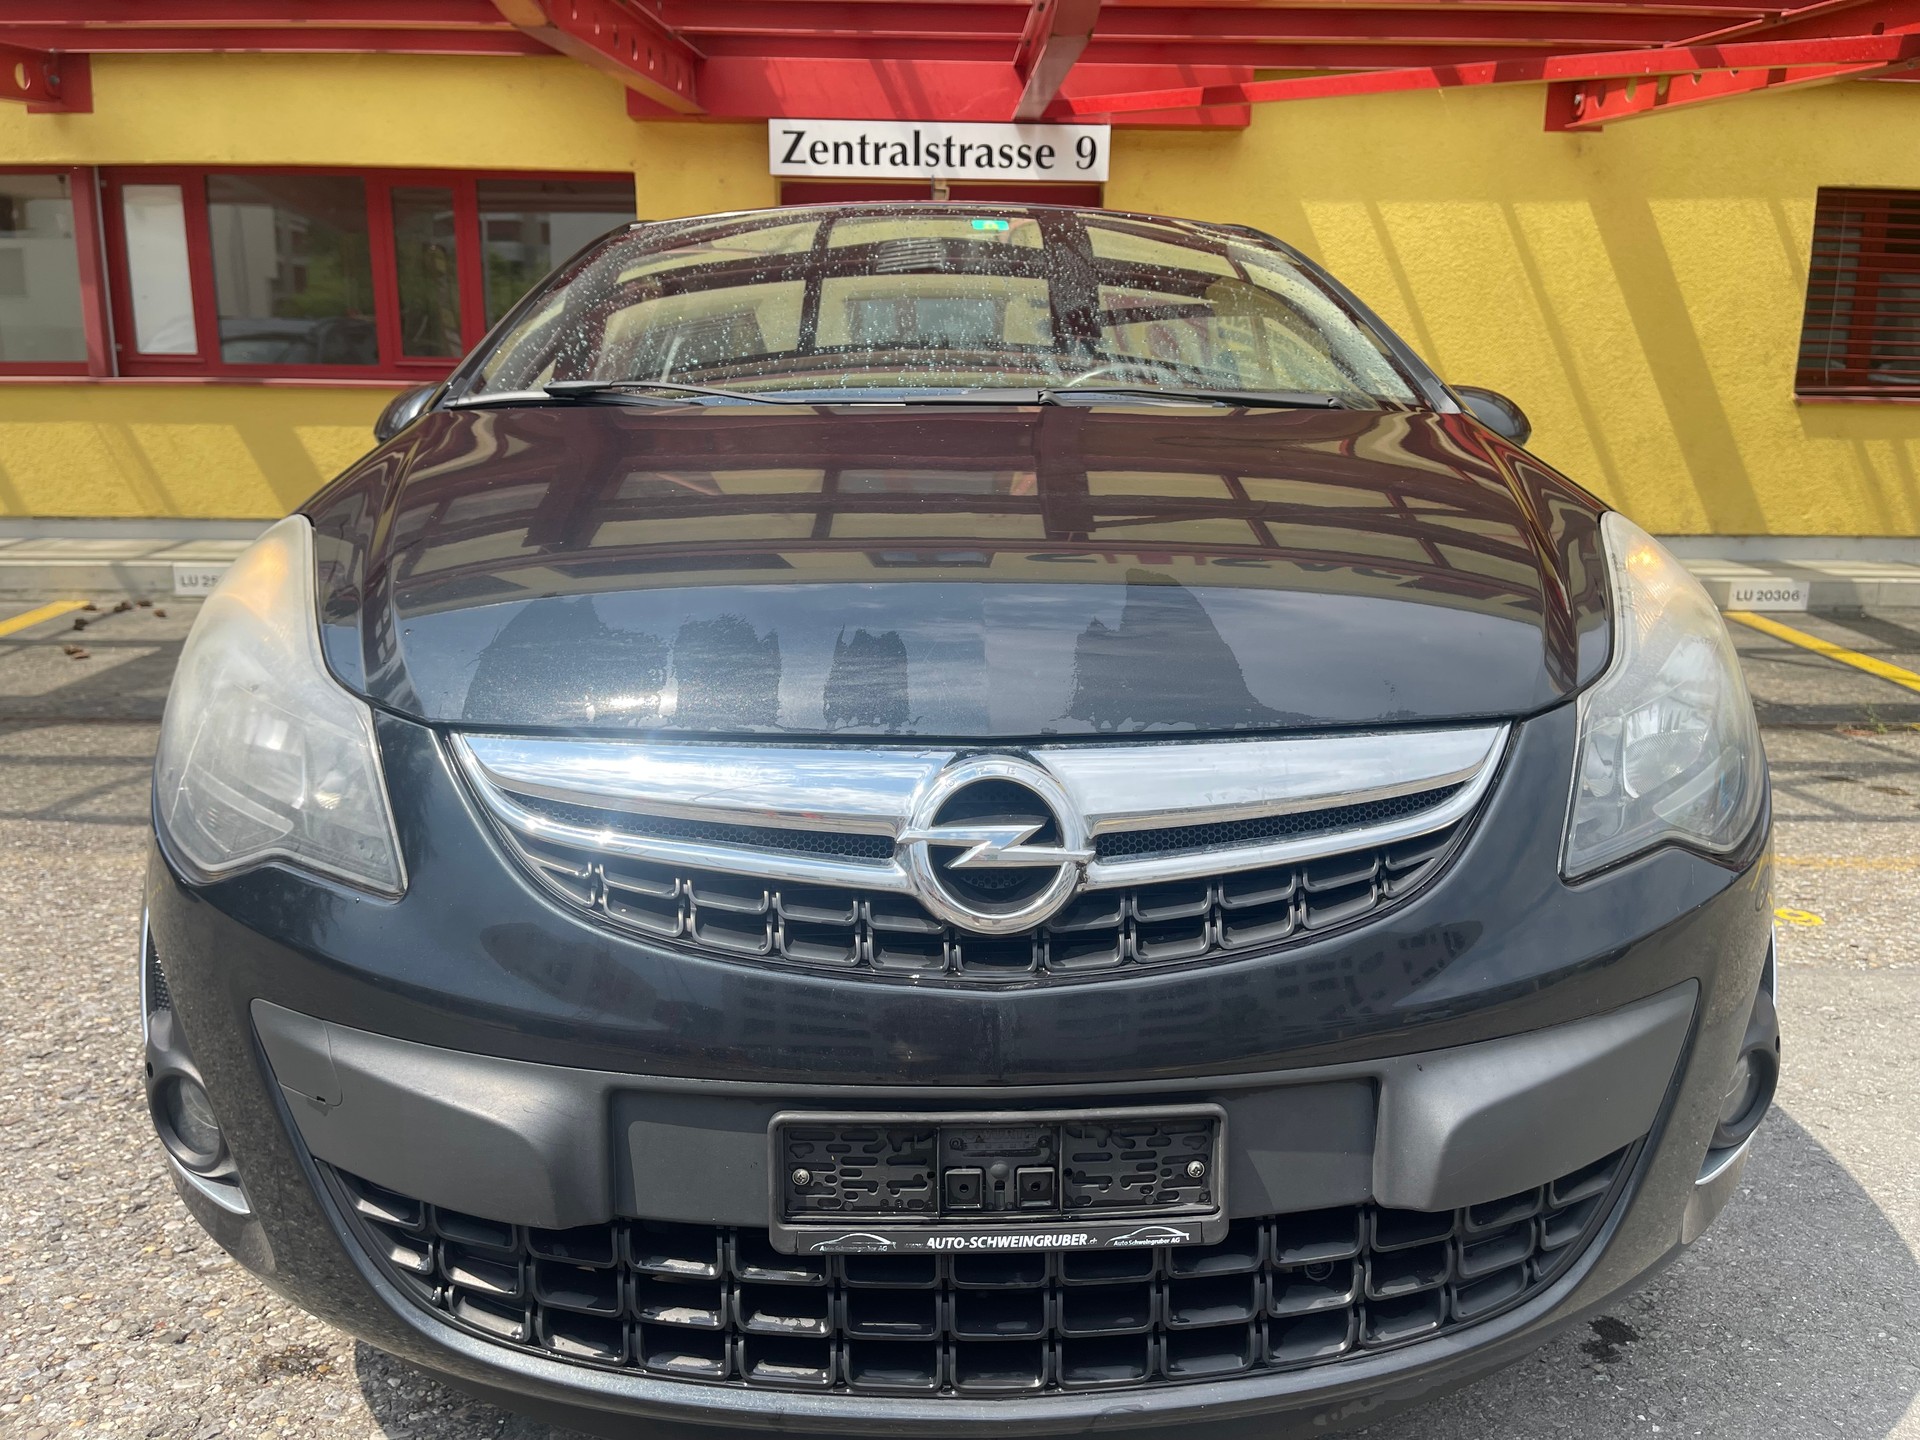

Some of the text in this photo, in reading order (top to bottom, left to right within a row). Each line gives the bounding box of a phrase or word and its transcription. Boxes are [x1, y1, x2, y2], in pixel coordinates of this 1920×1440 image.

[781, 130, 1097, 170] Zentralstrasse 9
[181, 574, 199, 588] LU
[1736, 589, 1800, 603] LU 20306
